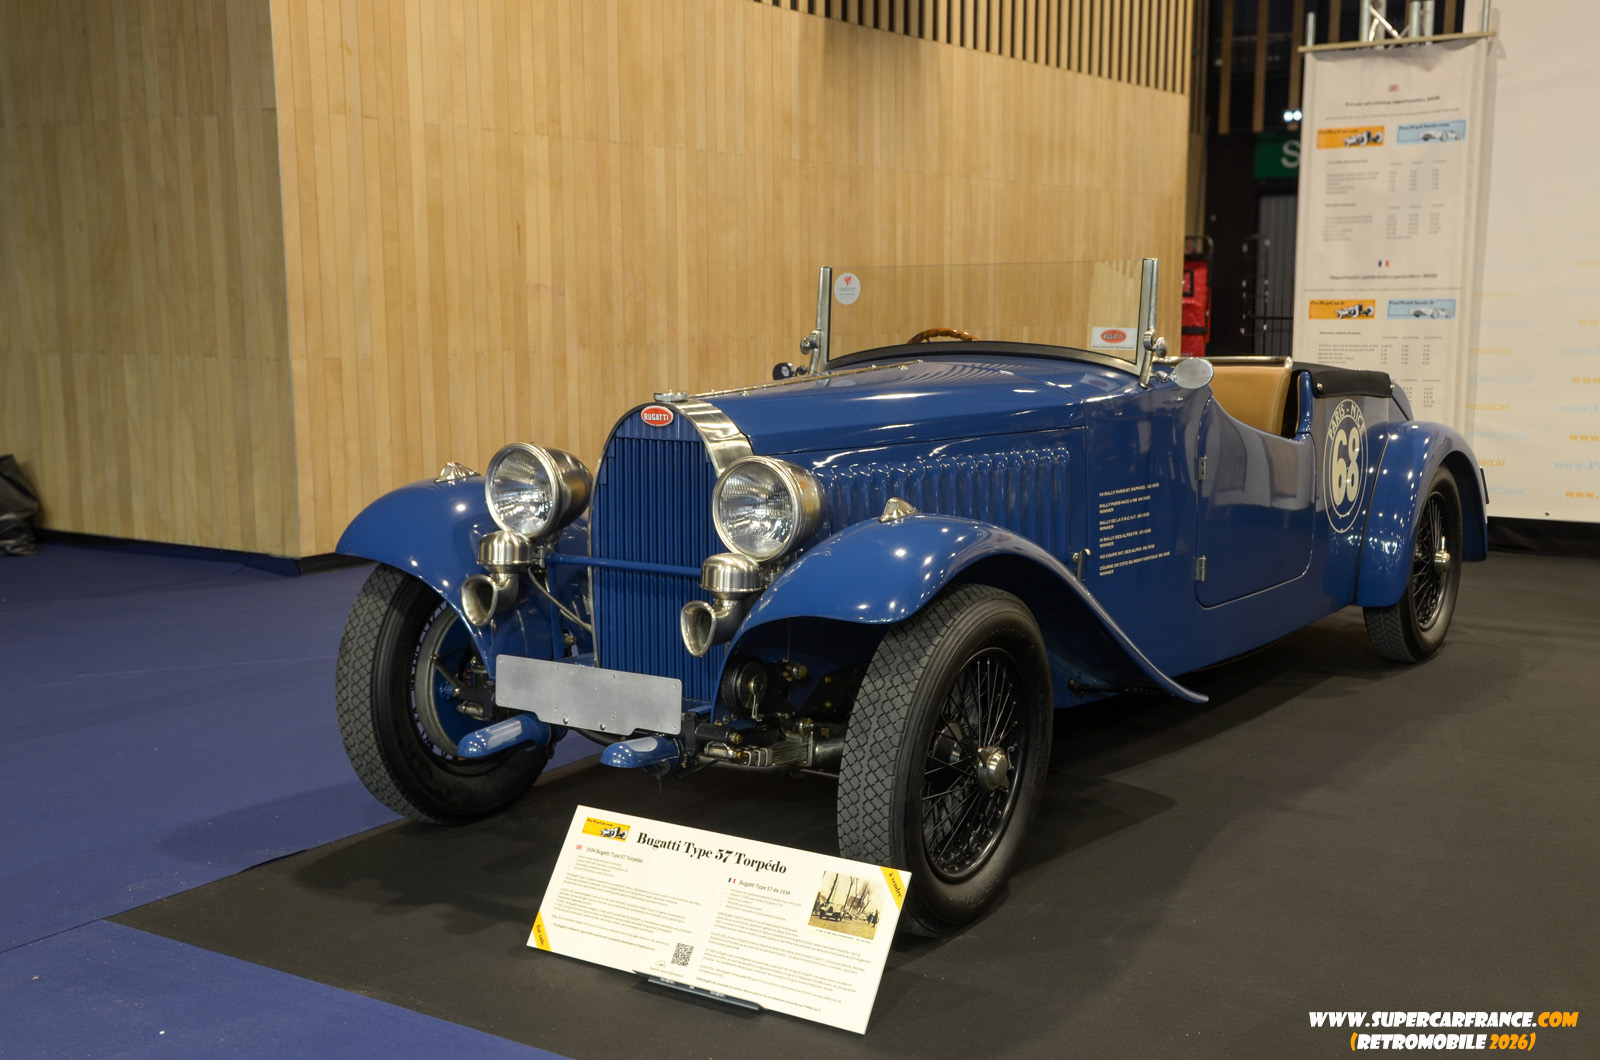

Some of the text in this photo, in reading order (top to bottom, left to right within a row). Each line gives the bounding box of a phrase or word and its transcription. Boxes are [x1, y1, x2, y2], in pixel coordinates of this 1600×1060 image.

[643, 413, 670, 421] BUGATTI
[1328, 403, 1366, 441] PARIS NICE
[1332, 426, 1360, 506] 68
[596, 848, 610, 858] Bugatti
[610, 851, 620, 860] Type
[636, 832, 788, 875] Bugatti Type 57 Torpédo
[738, 879, 755, 889] Bugatti
[755, 883, 766, 892] Type
[890, 879, 903, 898] vendre
